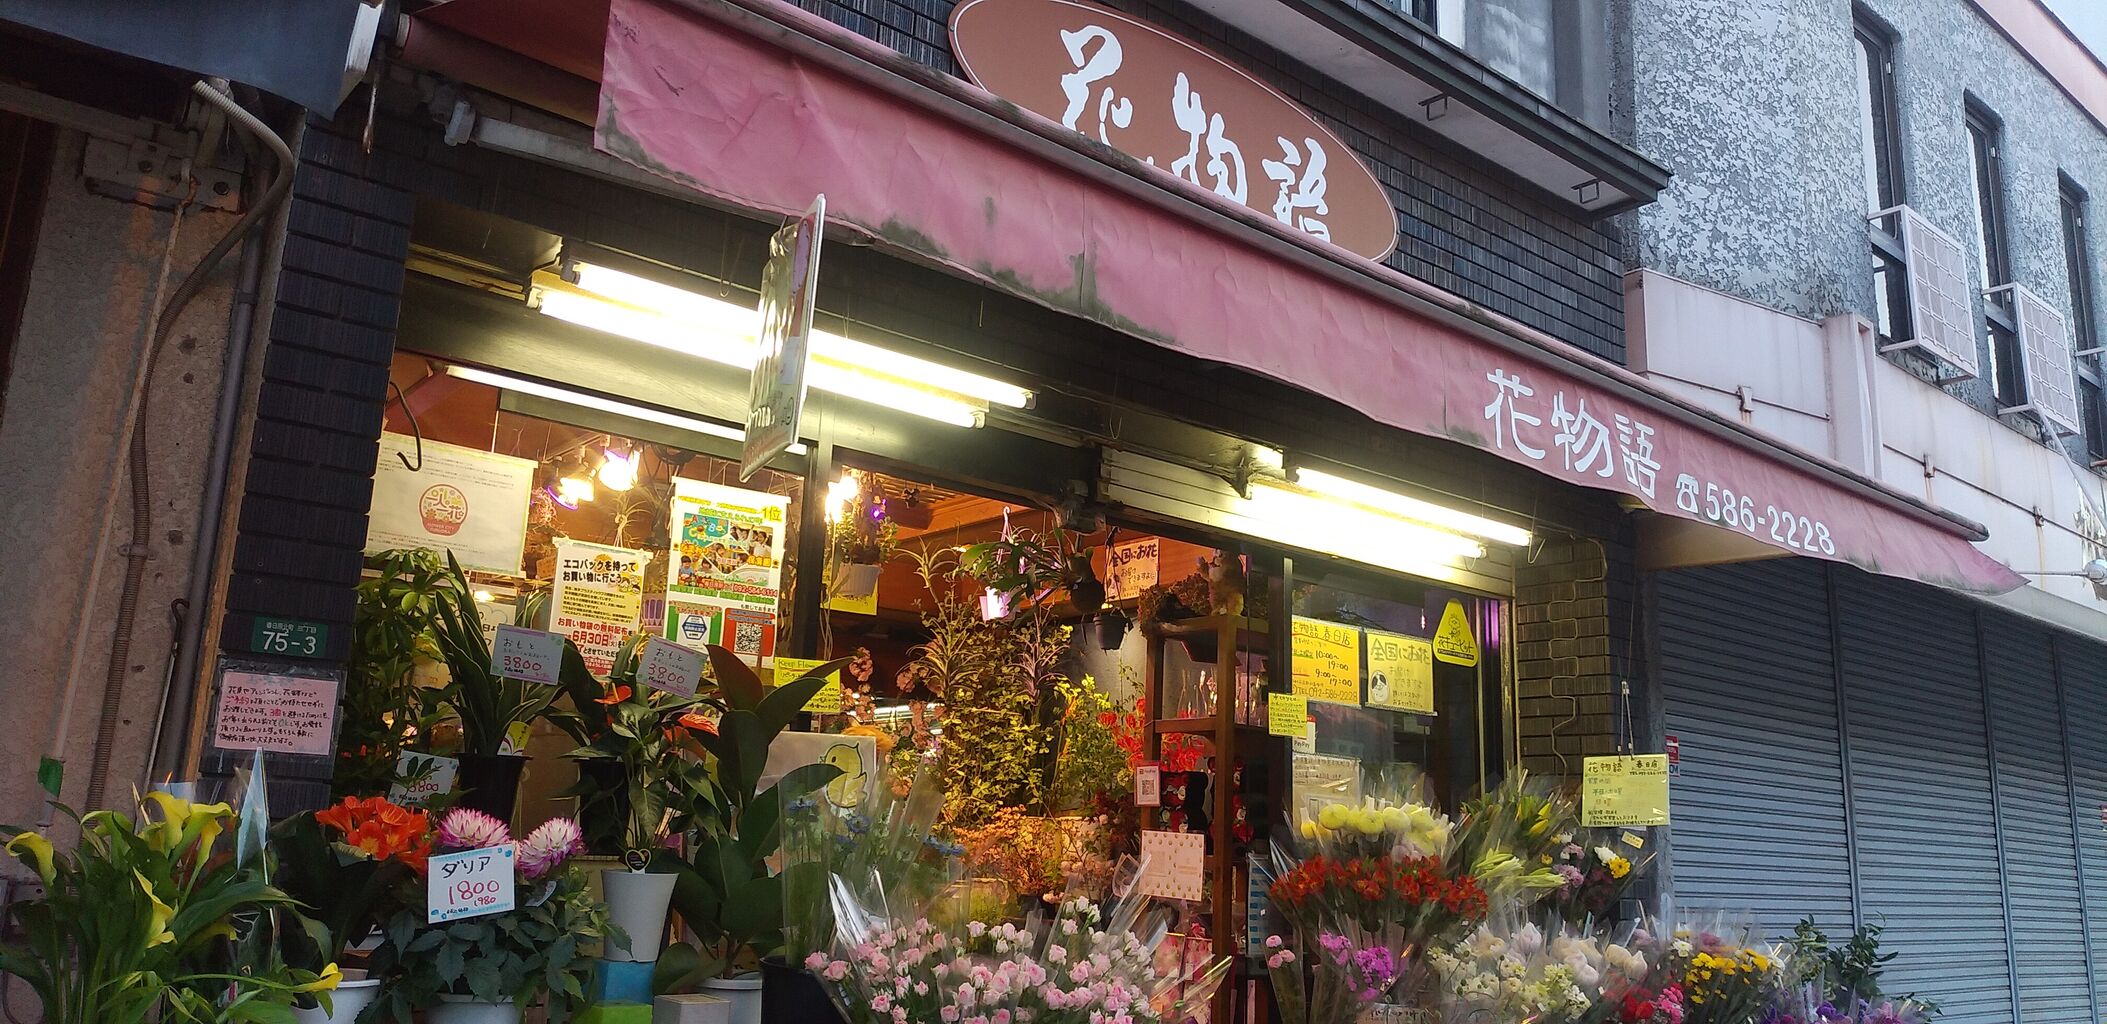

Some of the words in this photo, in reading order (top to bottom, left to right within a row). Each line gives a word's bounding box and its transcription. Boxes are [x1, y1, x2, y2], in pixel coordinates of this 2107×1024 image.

[1483, 368, 1662, 500] 花物語
[1704, 481, 1836, 557] 586-2228
[762, 505, 782, 521] 1位
[262, 630, 317, 655] 75-3
[503, 655, 542, 671] 3800
[1328, 660, 1349, 671] 19:00
[647, 663, 685, 684] 3800
[1294, 739, 1311, 749] PayPay
[1587, 761, 1623, 773] 花物語
[441, 856, 492, 879] ダリア
[448, 880, 500, 905] 1800
